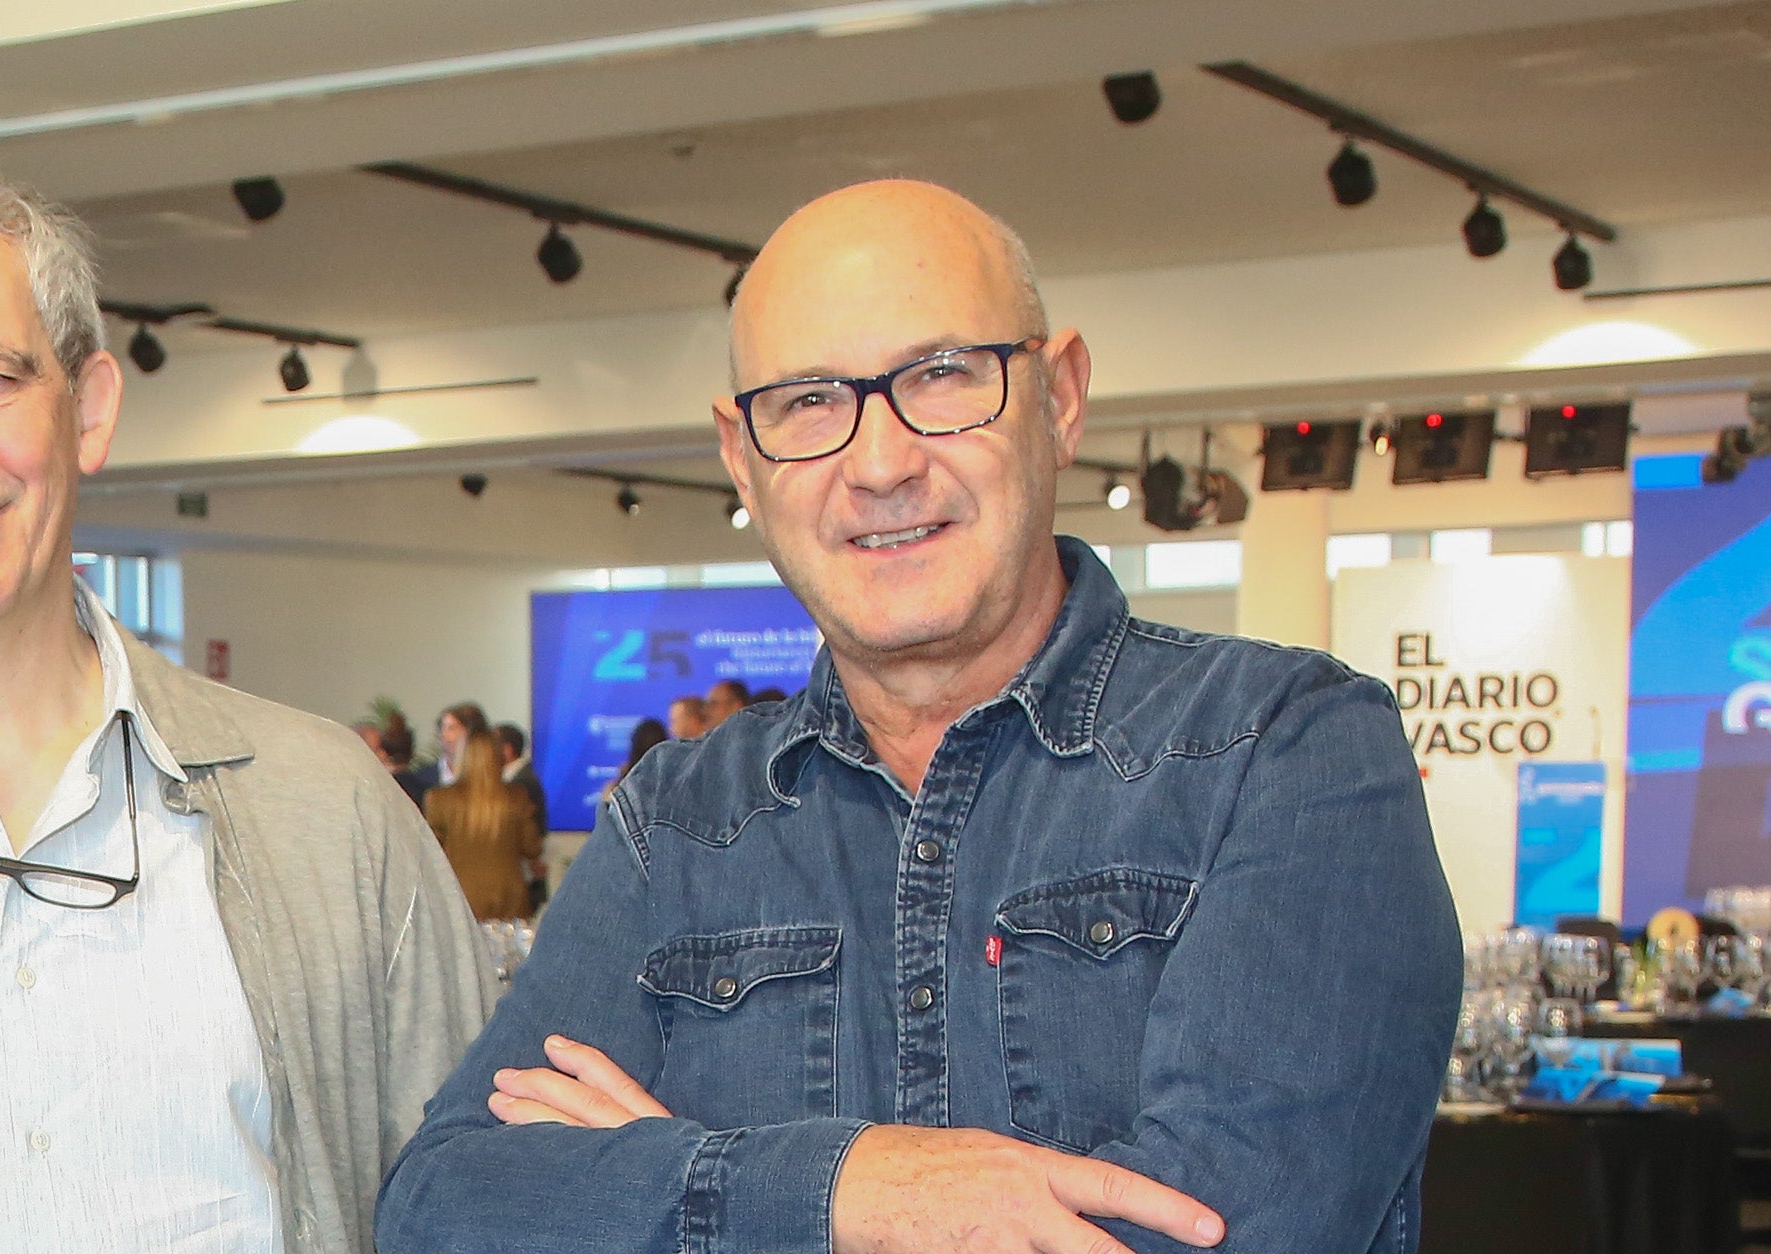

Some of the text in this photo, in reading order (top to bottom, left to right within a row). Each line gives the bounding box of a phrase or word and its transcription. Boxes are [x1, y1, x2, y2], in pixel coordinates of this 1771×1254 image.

[592, 629, 691, 679] 25
[1397, 634, 1444, 667] EL
[1396, 674, 1558, 710] DIARIO
